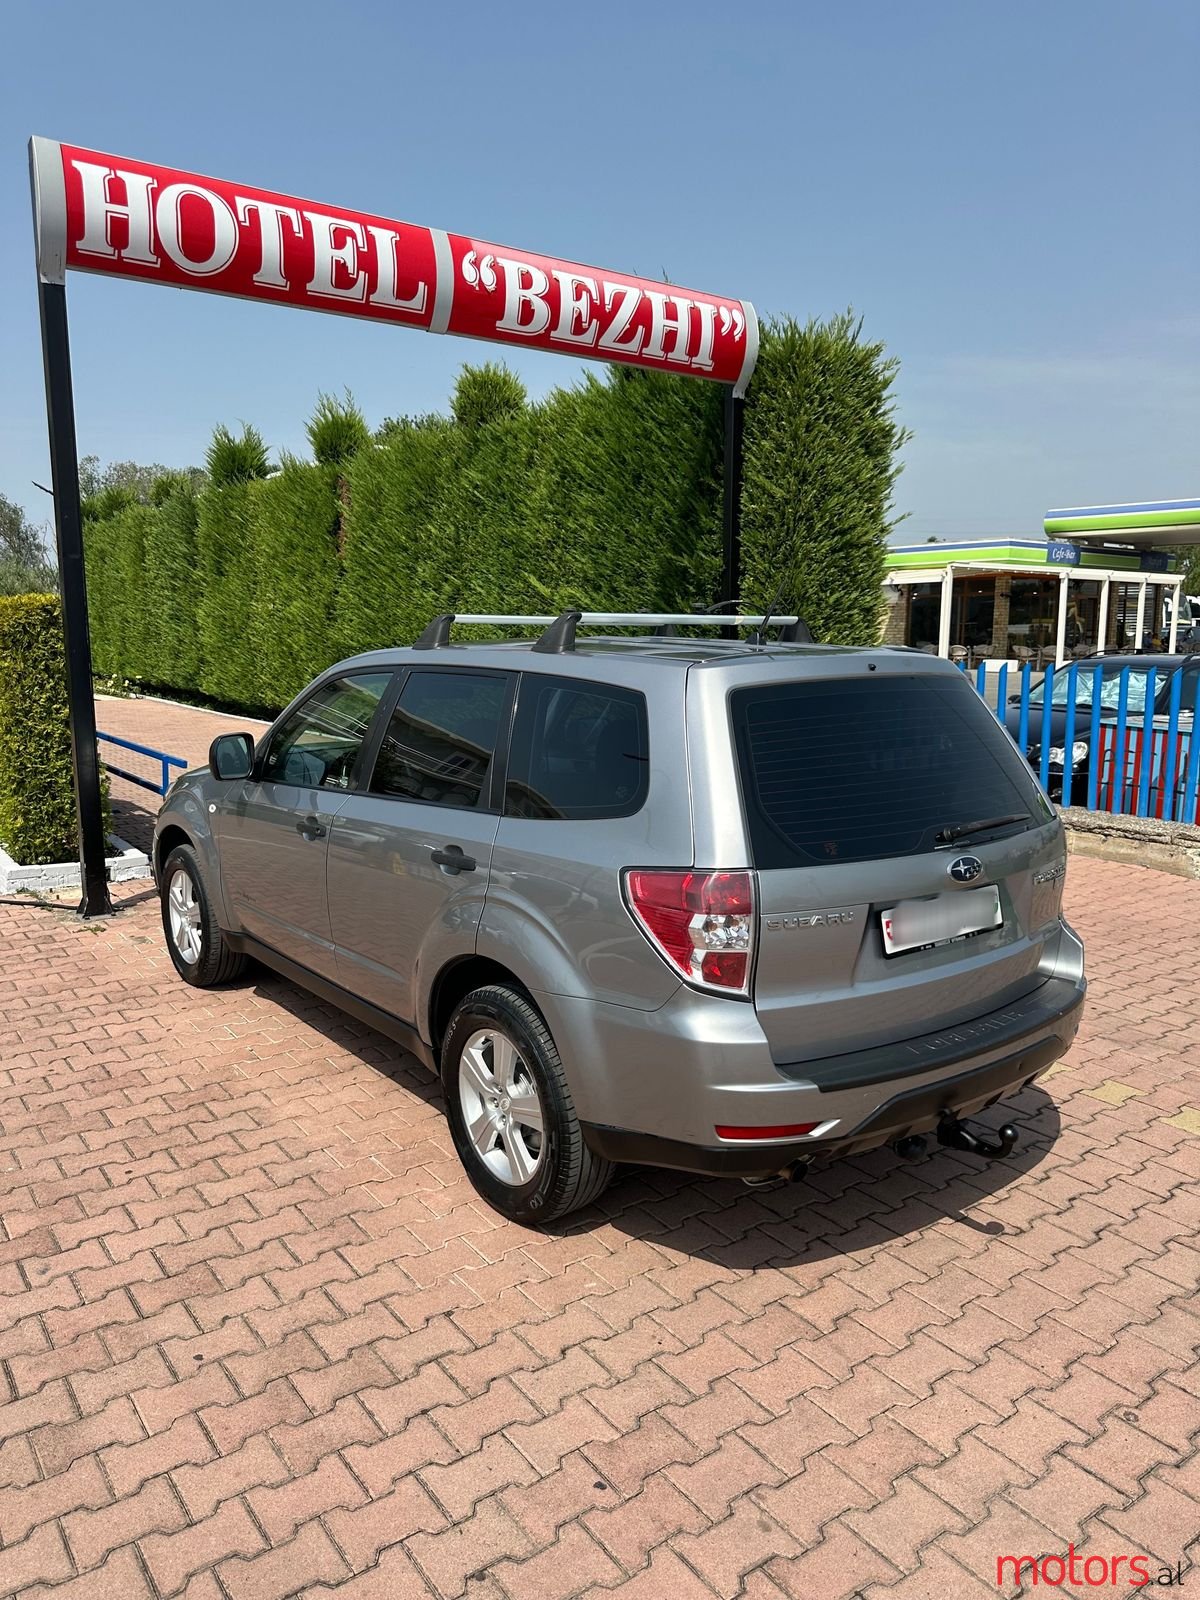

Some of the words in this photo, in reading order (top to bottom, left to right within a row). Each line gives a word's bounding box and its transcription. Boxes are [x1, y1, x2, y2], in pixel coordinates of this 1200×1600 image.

[71, 159, 428, 314] HOTEL
[461, 249, 746, 372] “BEZHI”
[766, 911, 855, 931] SUBARU
